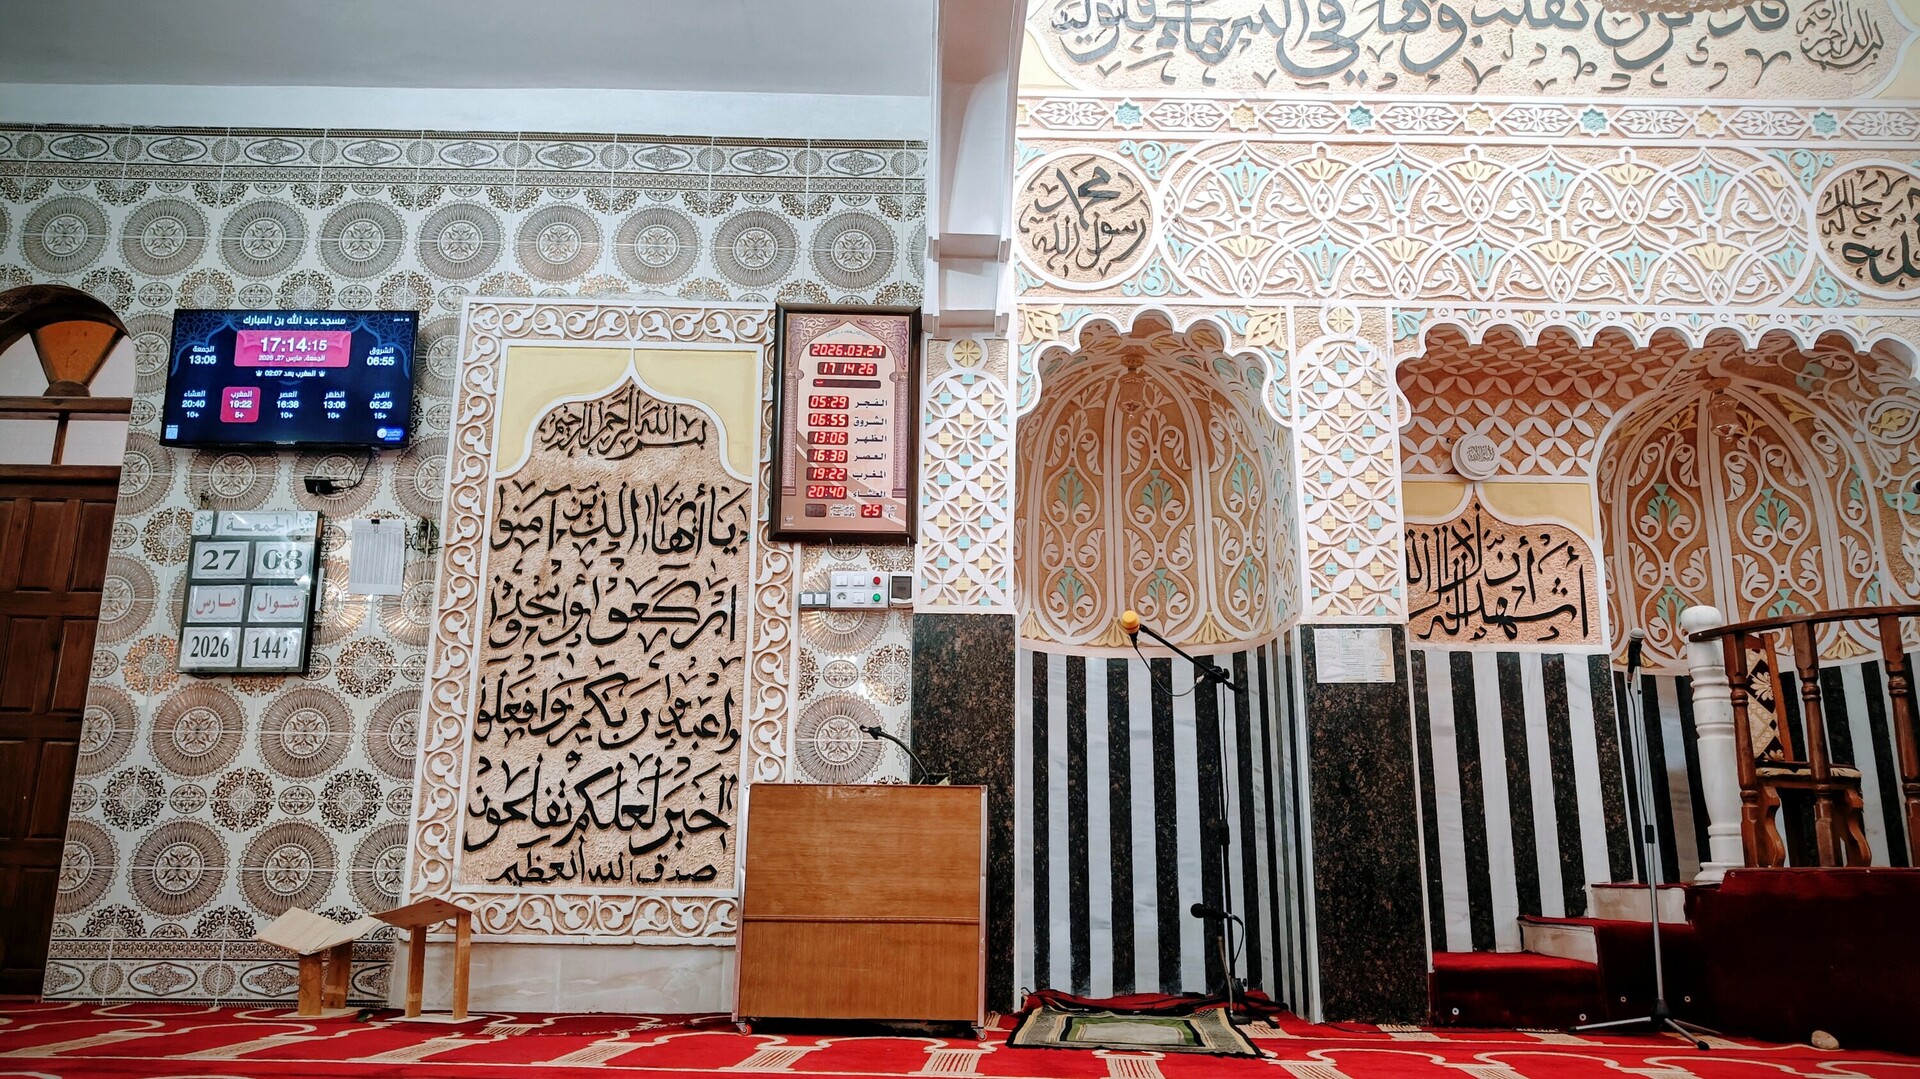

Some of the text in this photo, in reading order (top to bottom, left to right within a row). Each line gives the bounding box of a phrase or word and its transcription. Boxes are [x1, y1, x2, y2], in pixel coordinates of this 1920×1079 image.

[242, 312, 346, 326] مسجد عبد الله بن المبارك
[192, 346, 214, 354] الجمعة
[260, 337, 328, 352] 17:14:15
[370, 346, 394, 355] الشروق
[812, 344, 882, 356] 2026.03.27
[189, 355, 216, 364] 13:06
[367, 356, 394, 366] 06:55
[824, 363, 874, 374] 17 14 26
[279, 391, 298, 399] العصر
[325, 391, 346, 400] الظهر
[373, 392, 390, 400] الفجر
[276, 400, 300, 408] 16:38
[324, 400, 346, 408] 13:06
[370, 401, 392, 409] 05:29
[810, 396, 888, 408] الفجر 05:29
[810, 414, 887, 426] الشروق 06:55
[814, 432, 886, 444] الظهر 13:06
[814, 450, 886, 462] العصر 16:38
[812, 468, 886, 480] المغرب 19:22
[808, 486, 886, 498] العشاء 20:40
[864, 504, 880, 516] 25
[227, 516, 290, 534] الجمعة
[201, 550, 241, 571] 27
[262, 549, 304, 570] 08
[195, 592, 237, 616] مارس
[256, 593, 300, 615] شوال
[190, 635, 230, 658] 2026
[251, 636, 292, 660] 1447
[485, 836, 718, 887] صدق الله العظيم
